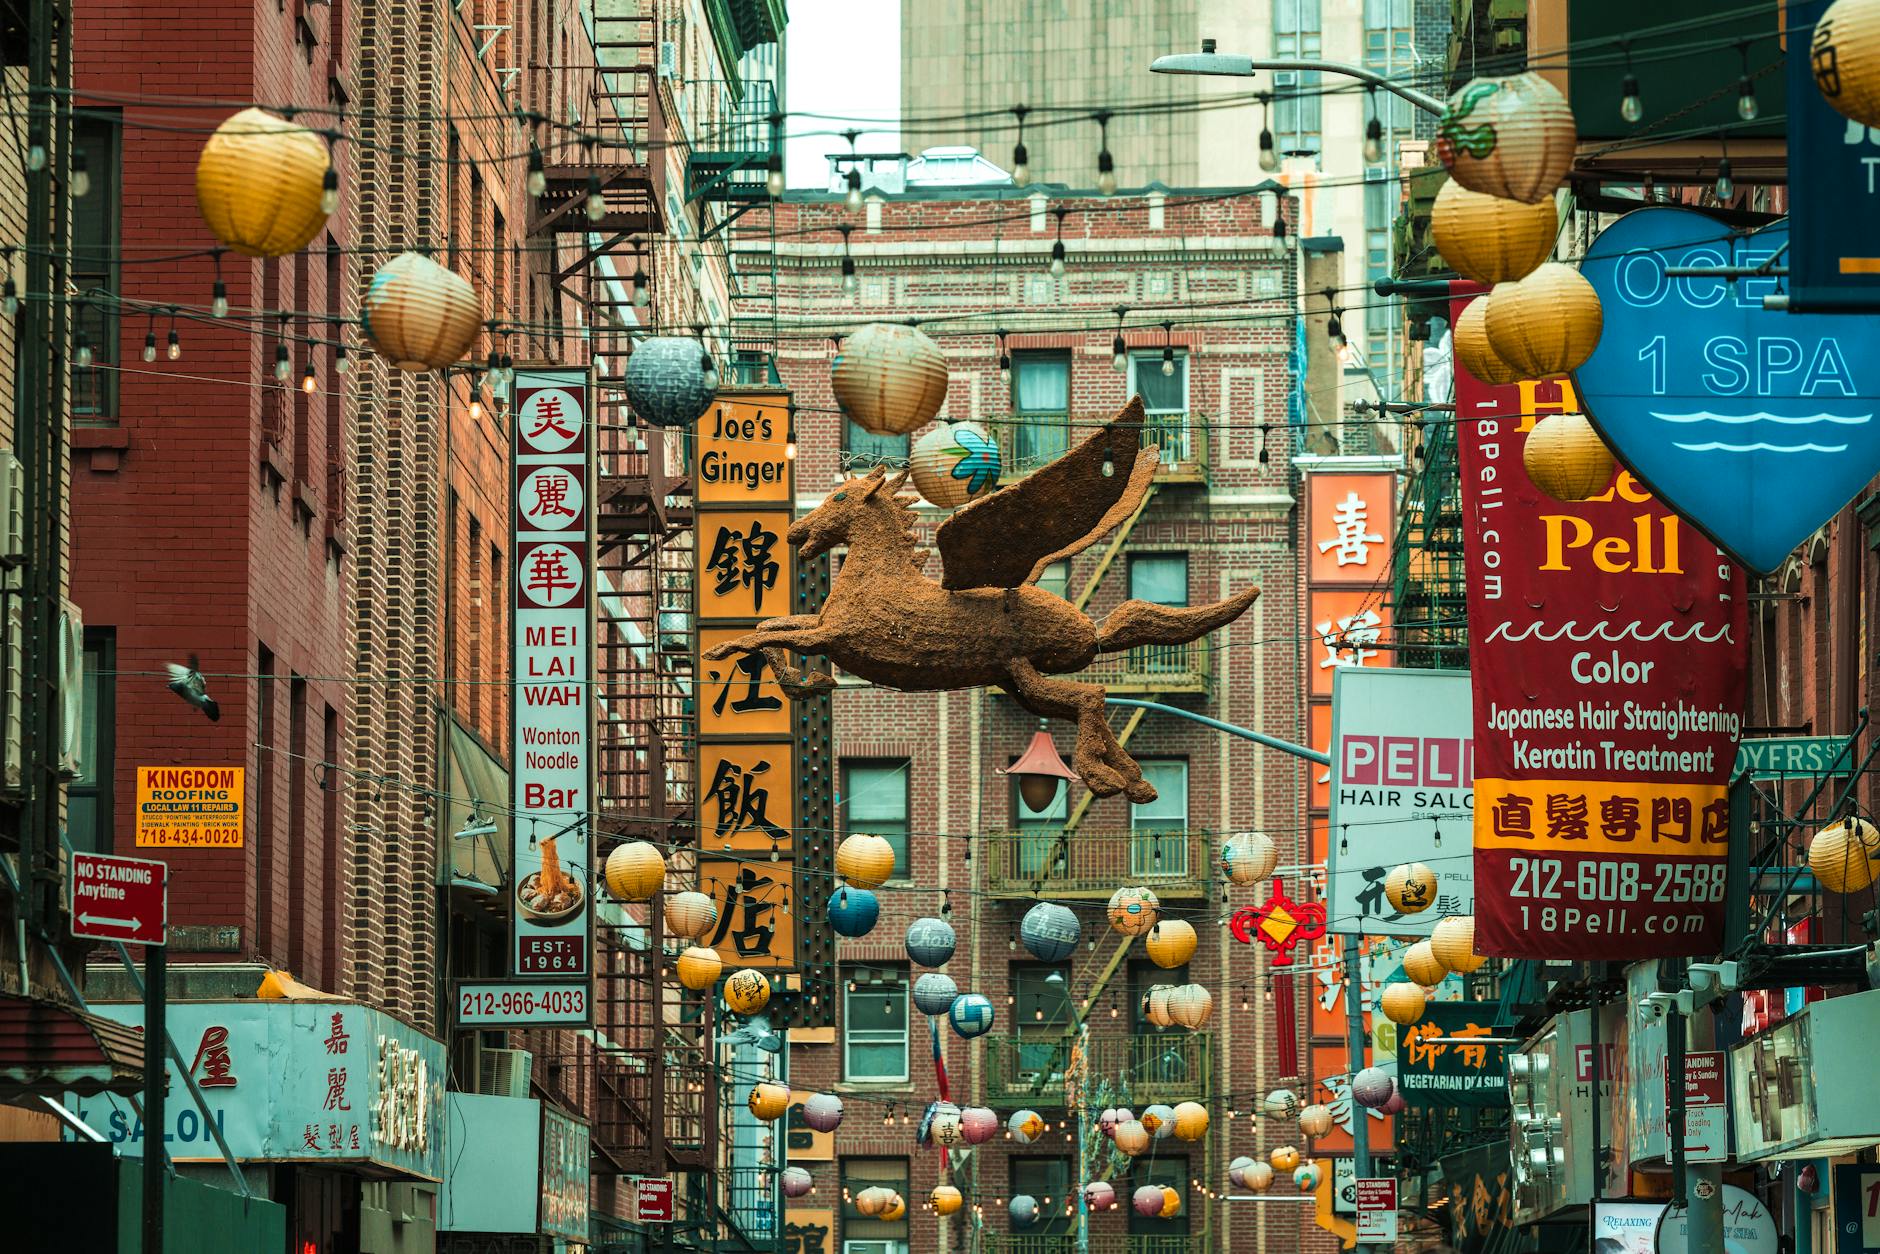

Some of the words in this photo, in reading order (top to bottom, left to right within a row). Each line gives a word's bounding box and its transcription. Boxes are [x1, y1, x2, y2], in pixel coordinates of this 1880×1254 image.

[1639, 336, 1665, 395] 1
[1702, 336, 1857, 396] SPA
[714, 409, 772, 441] Joe's
[701, 451, 785, 489] Ginger
[1538, 513, 1684, 574] Pell
[526, 626, 577, 646] MEI
[529, 656, 575, 676] LAI
[1571, 650, 1654, 684] Color
[524, 686, 580, 706] WAH
[1488, 702, 1574, 738] Japanese
[1579, 701, 1619, 730] Hair
[1623, 700, 1740, 743] Straightening
[523, 726, 580, 745] Wonton
[526, 751, 579, 769] Noodle
[1346, 741, 1474, 781] PEL
[1513, 740, 1596, 770] Keratin
[1600, 741, 1715, 773] Treatment
[147, 770, 234, 789] KINGDOM
[152, 790, 229, 800] ROOFING
[525, 783, 578, 809] Bar
[1341, 789, 1401, 807] HAIR
[147, 803, 171, 812] LOCAL
[173, 803, 190, 812] LAW
[191, 804, 200, 812] 11
[202, 803, 234, 812] REPAIRS
[142, 829, 238, 844] 718-434-0020
[78, 863, 94, 879] NO
[97, 865, 152, 885] STANDING
[1509, 857, 1727, 902] 212-608-2588
[78, 881, 126, 901] Anytime
[1520, 906, 1705, 934] 18Pell.com
[531, 941, 571, 953] EST:
[524, 956, 577, 969] 1964
[463, 990, 584, 1016] 212-966-4033
[1685, 1056, 1715, 1069] TANDING
[1403, 1074, 1463, 1090] VEGETARIAN
[1698, 1070, 1719, 1081] Sunday
[1687, 1109, 1704, 1117] Truck
[1687, 1118, 1711, 1128] Loading
[1688, 1128, 1701, 1137] Only
